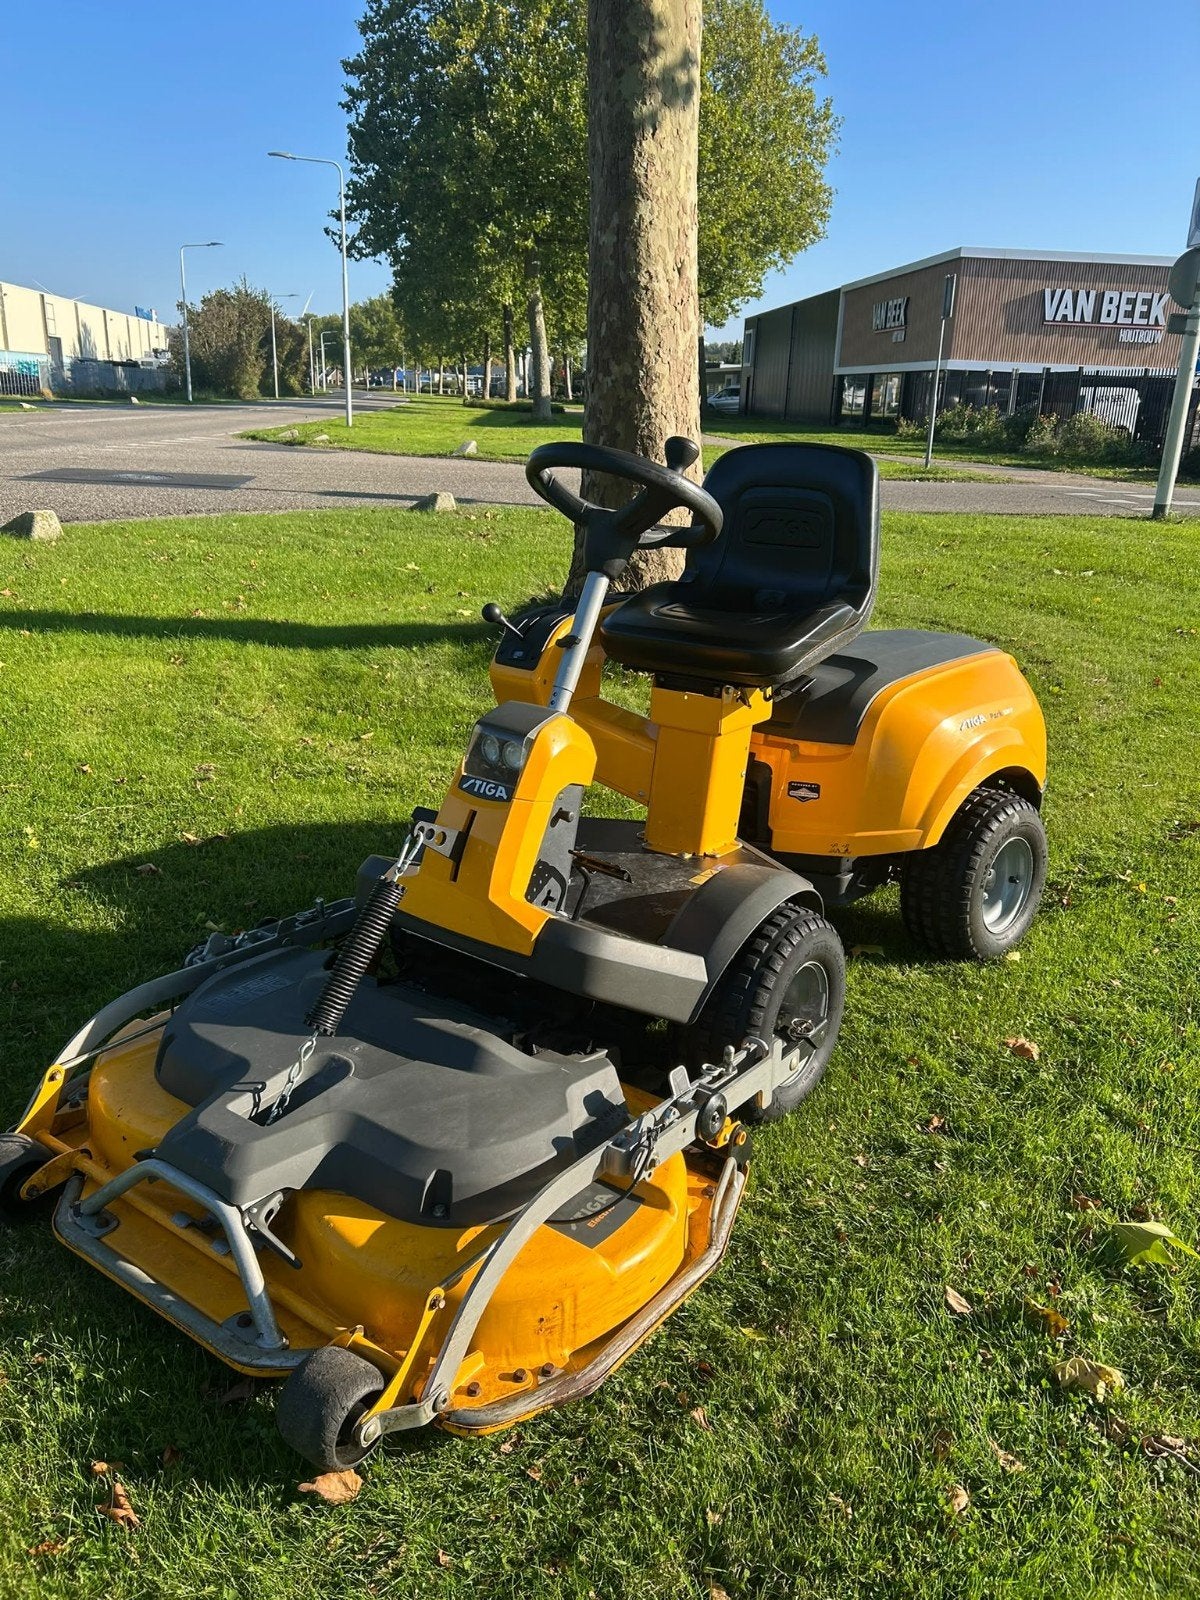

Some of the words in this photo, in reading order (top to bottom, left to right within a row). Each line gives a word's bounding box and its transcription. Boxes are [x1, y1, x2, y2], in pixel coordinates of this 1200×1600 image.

[872, 302, 888, 330] VAN
[885, 296, 909, 328] BEEK
[1044, 287, 1097, 323] VAN
[1099, 290, 1171, 326] BEEK
[1118, 328, 1164, 344] HOUTBOUW
[462, 778, 508, 800] STIGA
